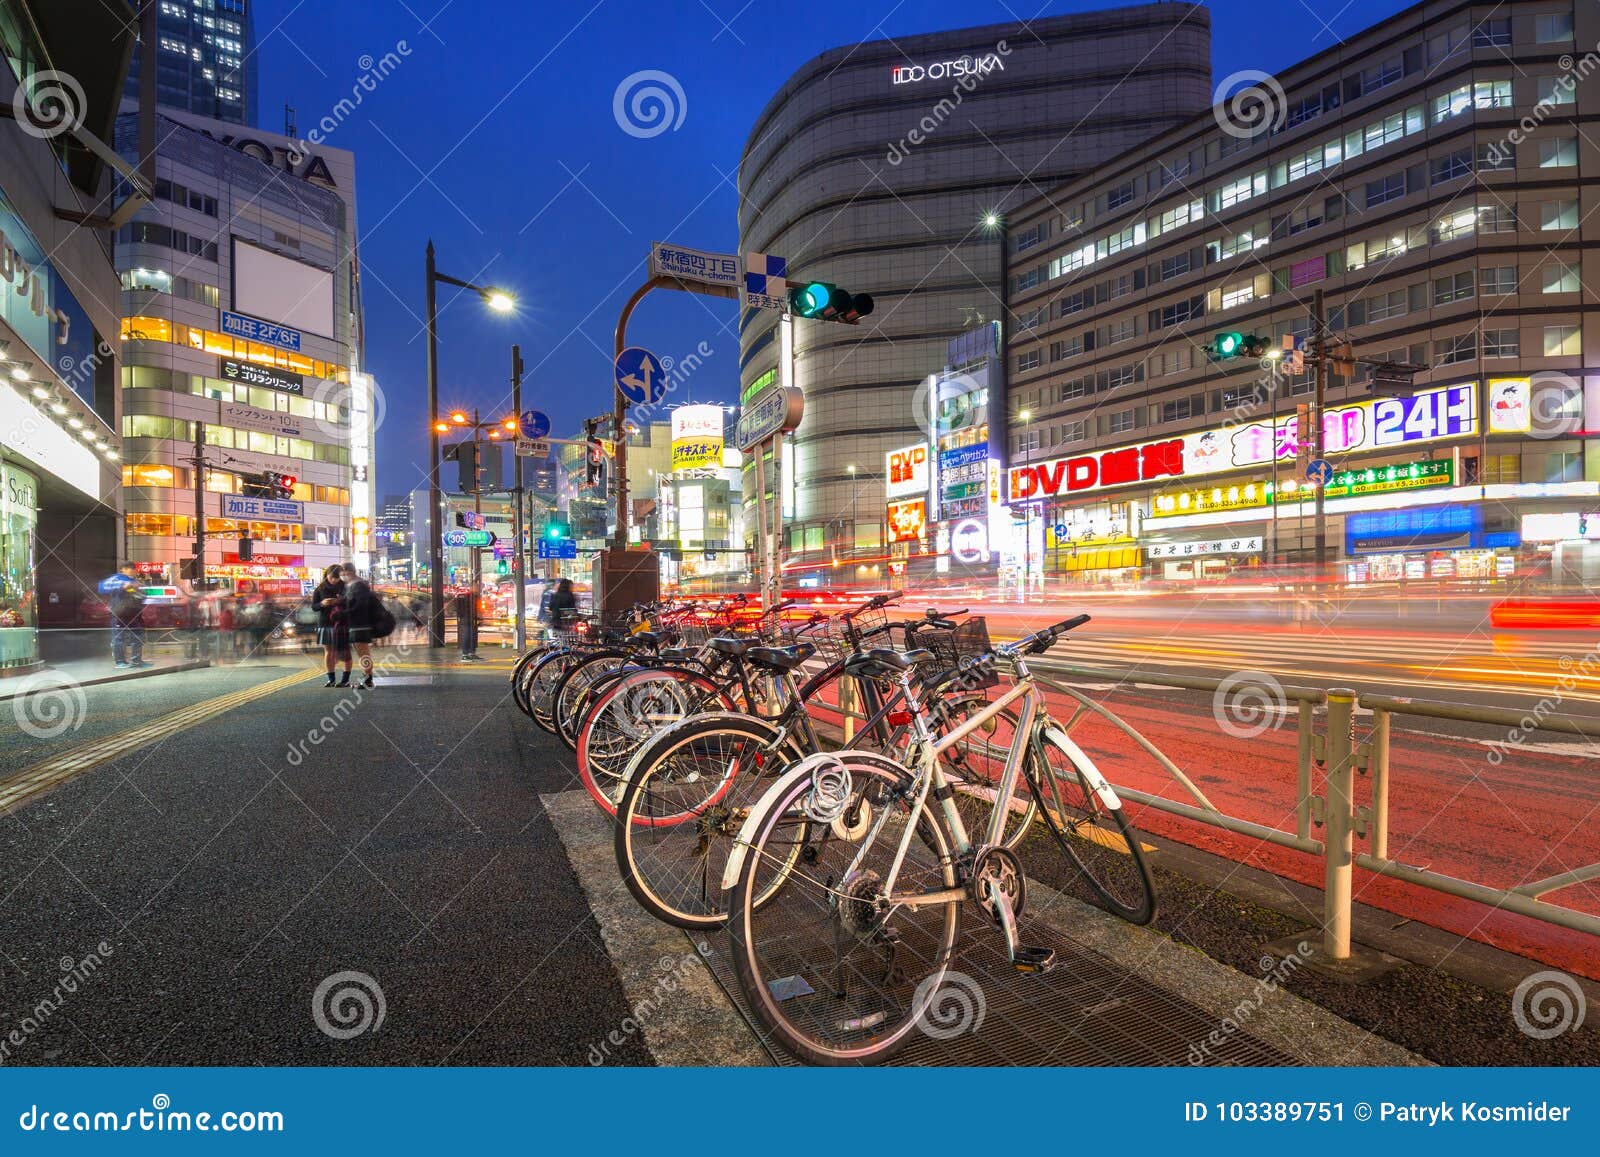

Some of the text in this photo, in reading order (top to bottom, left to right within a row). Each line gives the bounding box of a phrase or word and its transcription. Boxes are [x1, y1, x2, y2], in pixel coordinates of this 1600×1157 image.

[928, 56, 1004, 79] OTSUKA
[660, 248, 736, 274] 新宿四丁目
[661, 261, 737, 281] Shinjuku 4-chome
[259, 324, 298, 344] 2F/6F
[241, 371, 300, 391] ゴリラクリニック
[227, 408, 274, 421] インプラント
[1376, 387, 1471, 443] 24H
[890, 448, 926, 465] DVD
[228, 500, 259, 515] 加圧
[450, 535, 466, 544] 305
[1153, 540, 1257, 556] おそば 増田屋
